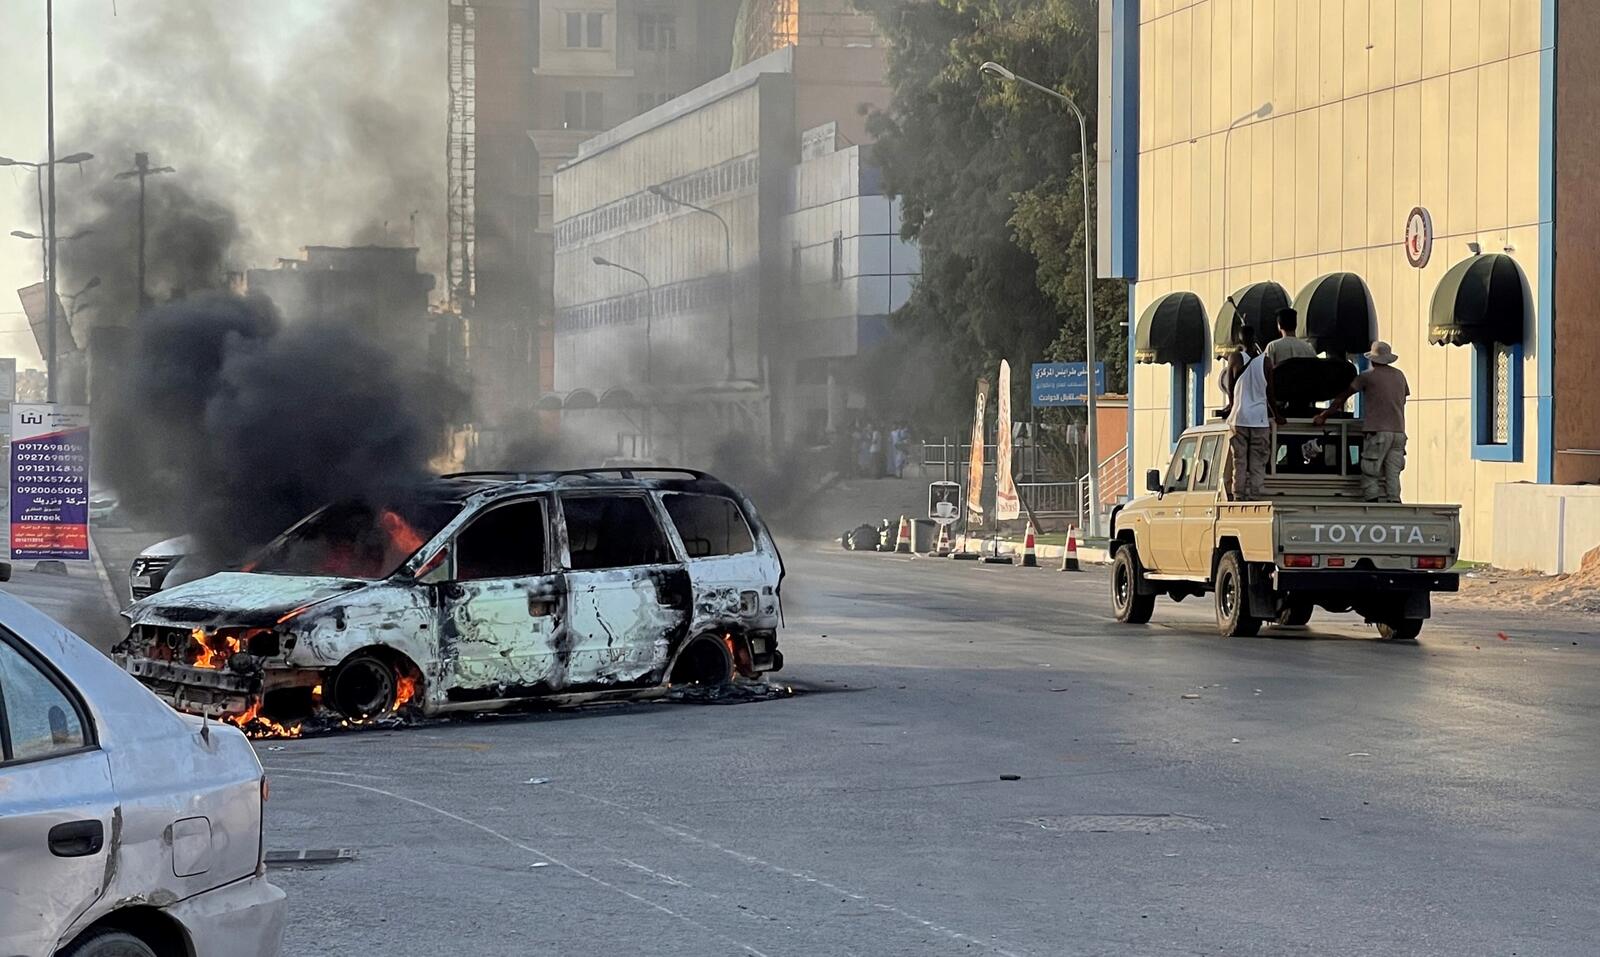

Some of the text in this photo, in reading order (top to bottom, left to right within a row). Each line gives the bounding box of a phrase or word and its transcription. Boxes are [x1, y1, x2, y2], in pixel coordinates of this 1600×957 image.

[18, 475, 83, 483] 0913457471
[17, 486, 83, 495] 0920065005
[66, 497, 87, 506] شركة
[1310, 524, 1424, 544] TOYOTA
